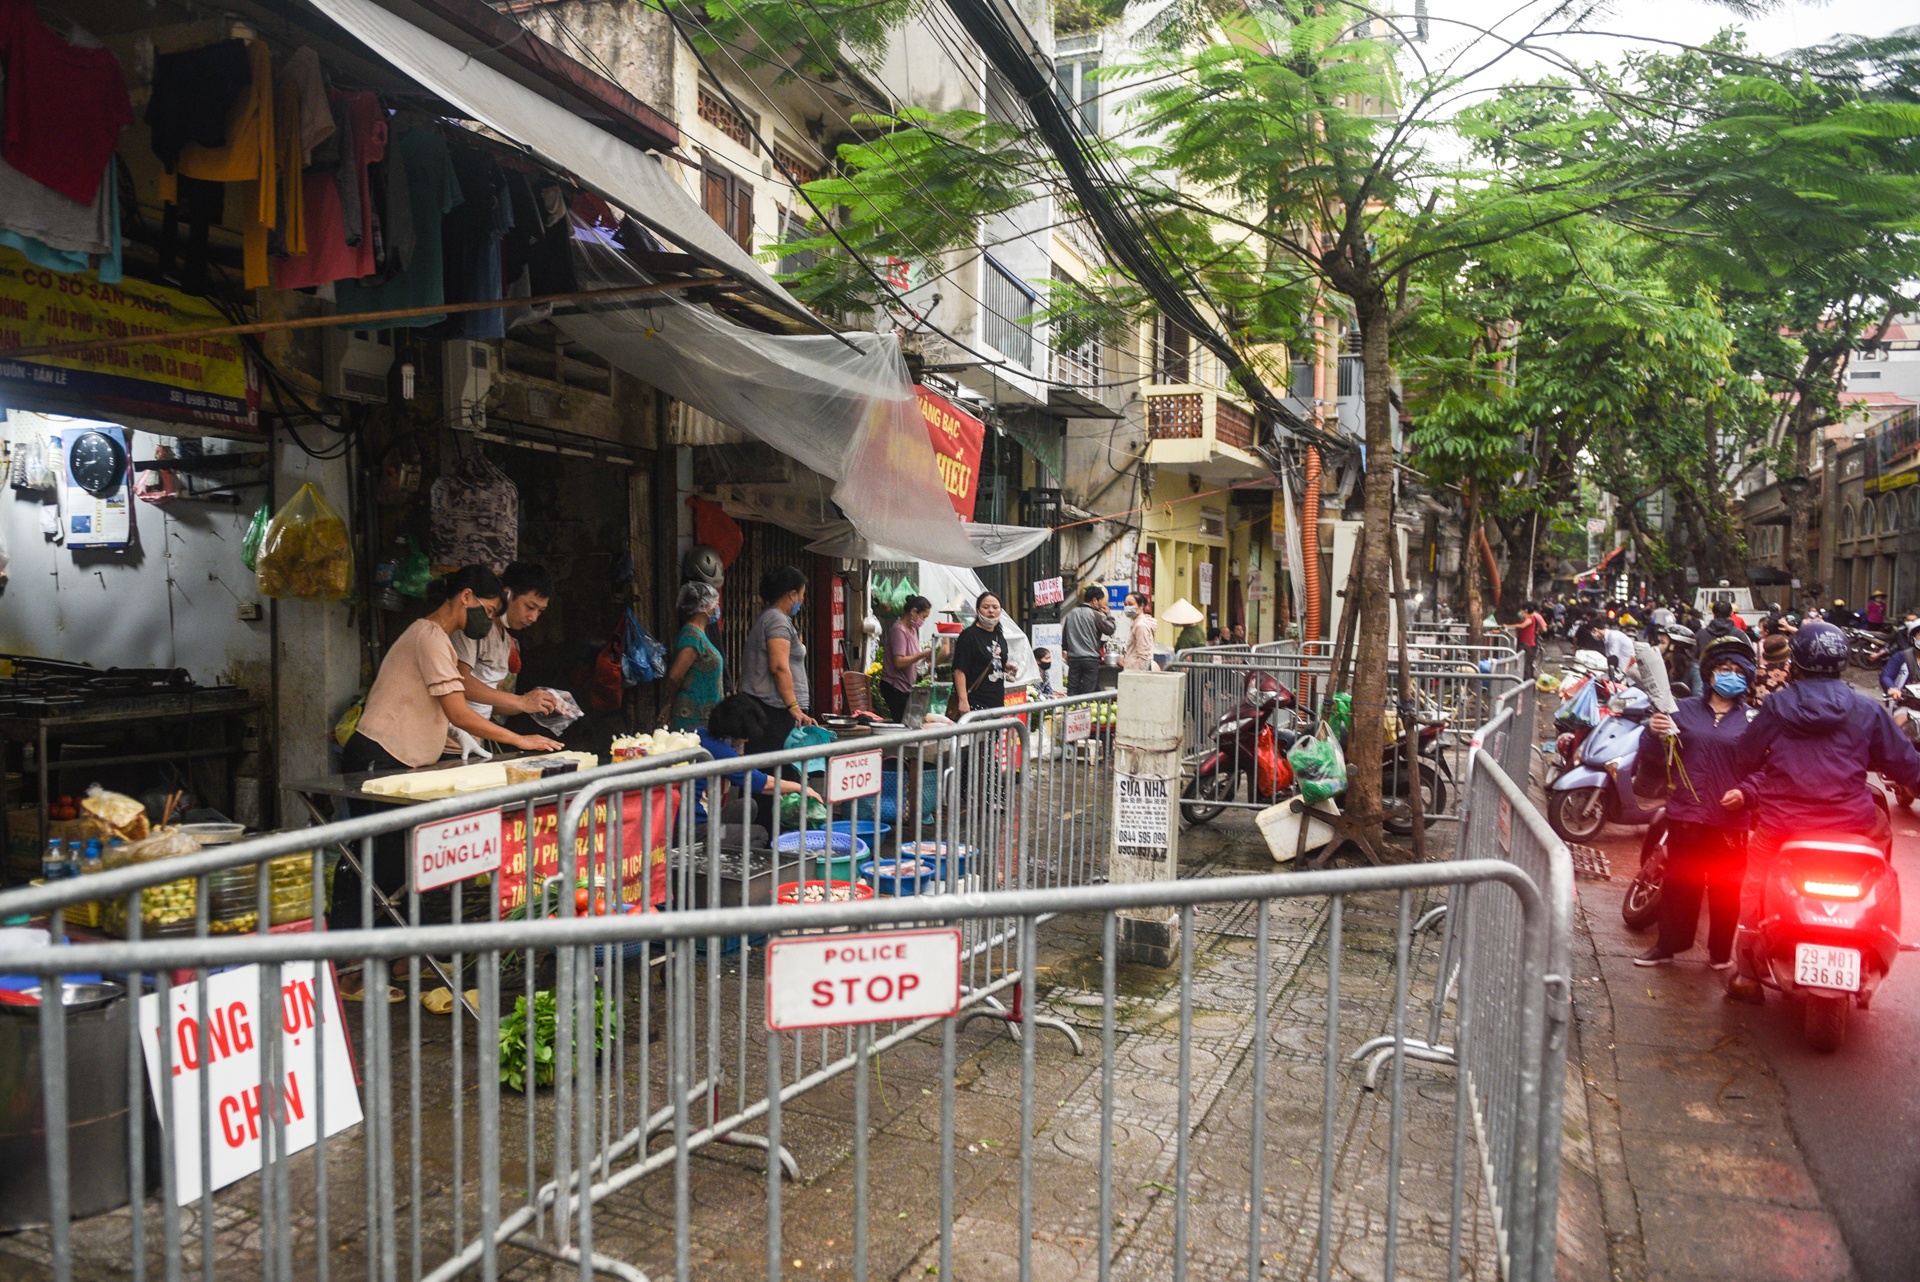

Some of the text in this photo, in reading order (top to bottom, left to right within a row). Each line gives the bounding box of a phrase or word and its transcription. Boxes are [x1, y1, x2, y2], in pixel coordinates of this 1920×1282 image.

[59, 273, 84, 296] SỞ
[942, 411, 961, 440] BẠC
[845, 757, 869, 769] POLICE
[841, 772, 872, 792] STOP
[472, 837, 497, 860] LẠI
[1119, 830, 1167, 844] 0844 595 099
[824, 943, 908, 964] POLICE
[1800, 966, 1855, 987] 236.83
[811, 973, 920, 1008] STOP
[281, 979, 326, 1046] ỢN
[218, 1071, 305, 1149] CHN
